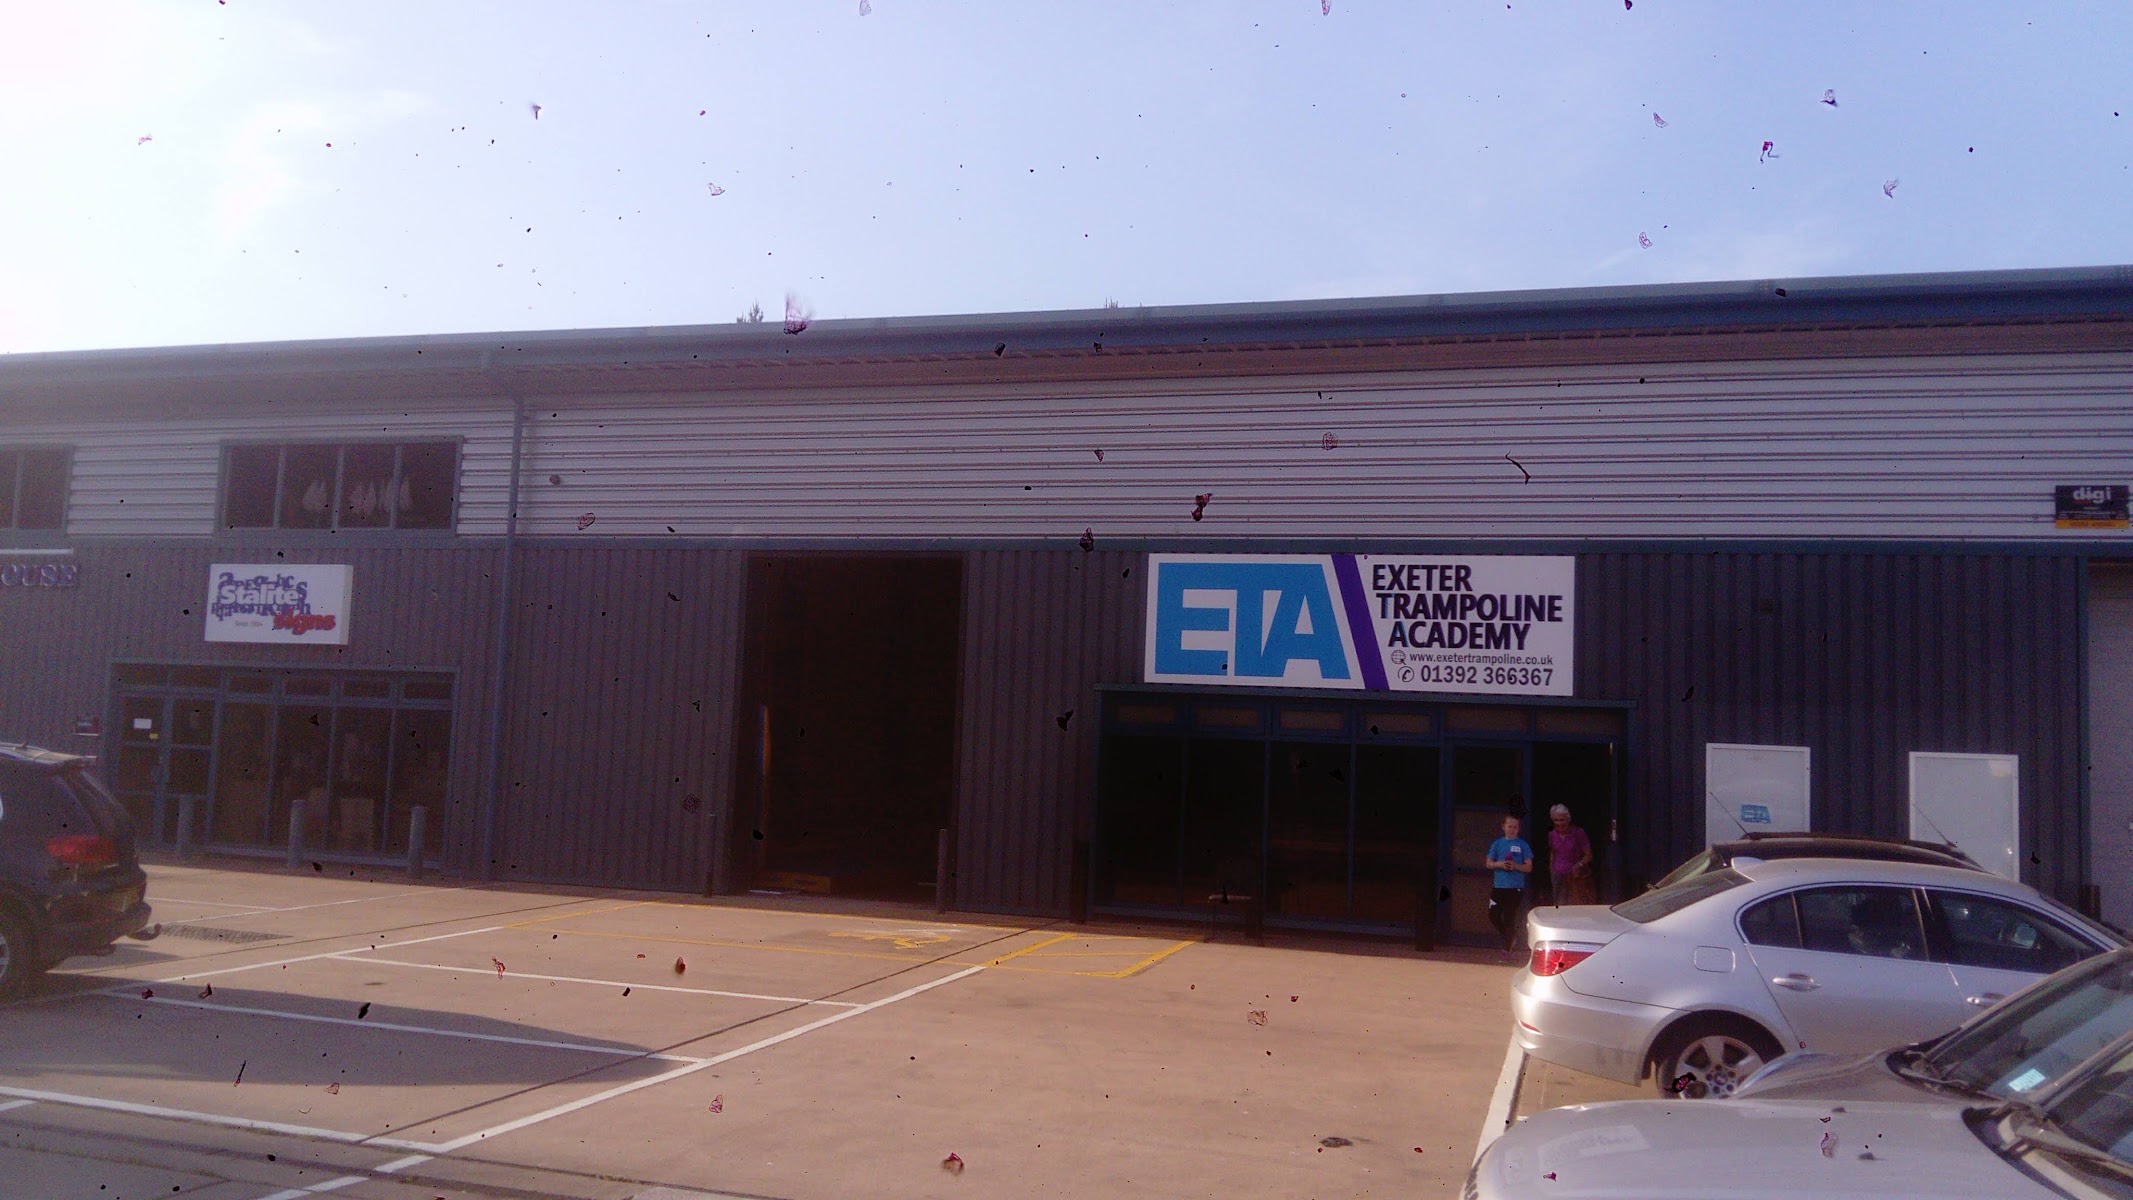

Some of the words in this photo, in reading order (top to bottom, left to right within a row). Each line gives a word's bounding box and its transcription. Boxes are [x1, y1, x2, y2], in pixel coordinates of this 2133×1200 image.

[2073, 487, 2111, 504] digi
[1373, 564, 1473, 591] EXETER
[219, 582, 301, 605] Stalite
[1155, 562, 1351, 680] ETA
[1376, 593, 1563, 622] TRAMPOLINE
[273, 608, 336, 635] signs
[1388, 621, 1531, 650] ACADEMY
[1409, 652, 1554, 666] www.exetertrampoline.co.uk
[1420, 665, 1478, 684] 01392
[1483, 666, 1554, 687] 366367
